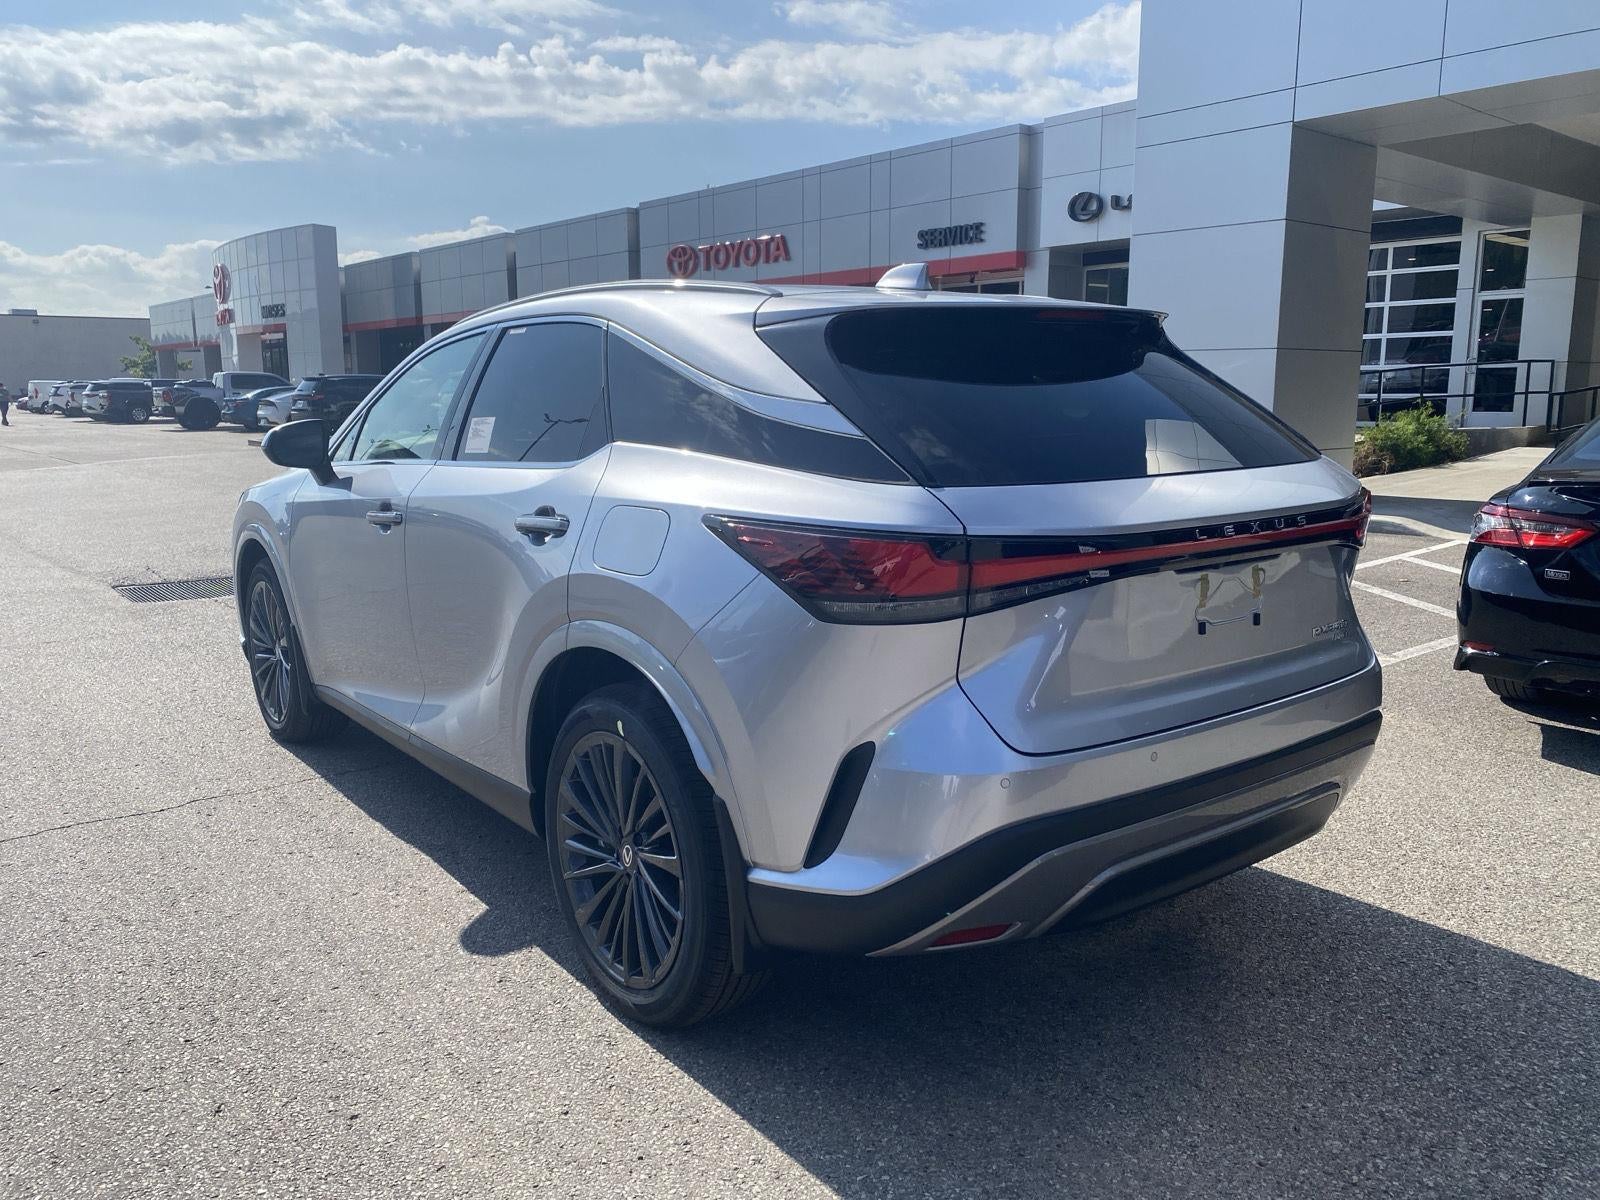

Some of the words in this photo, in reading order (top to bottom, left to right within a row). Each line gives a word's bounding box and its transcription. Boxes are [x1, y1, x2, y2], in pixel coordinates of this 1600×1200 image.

[917, 222, 986, 250] SERVICE
[698, 234, 791, 271] TOYOTA
[1195, 515, 1307, 540] LEXUS
